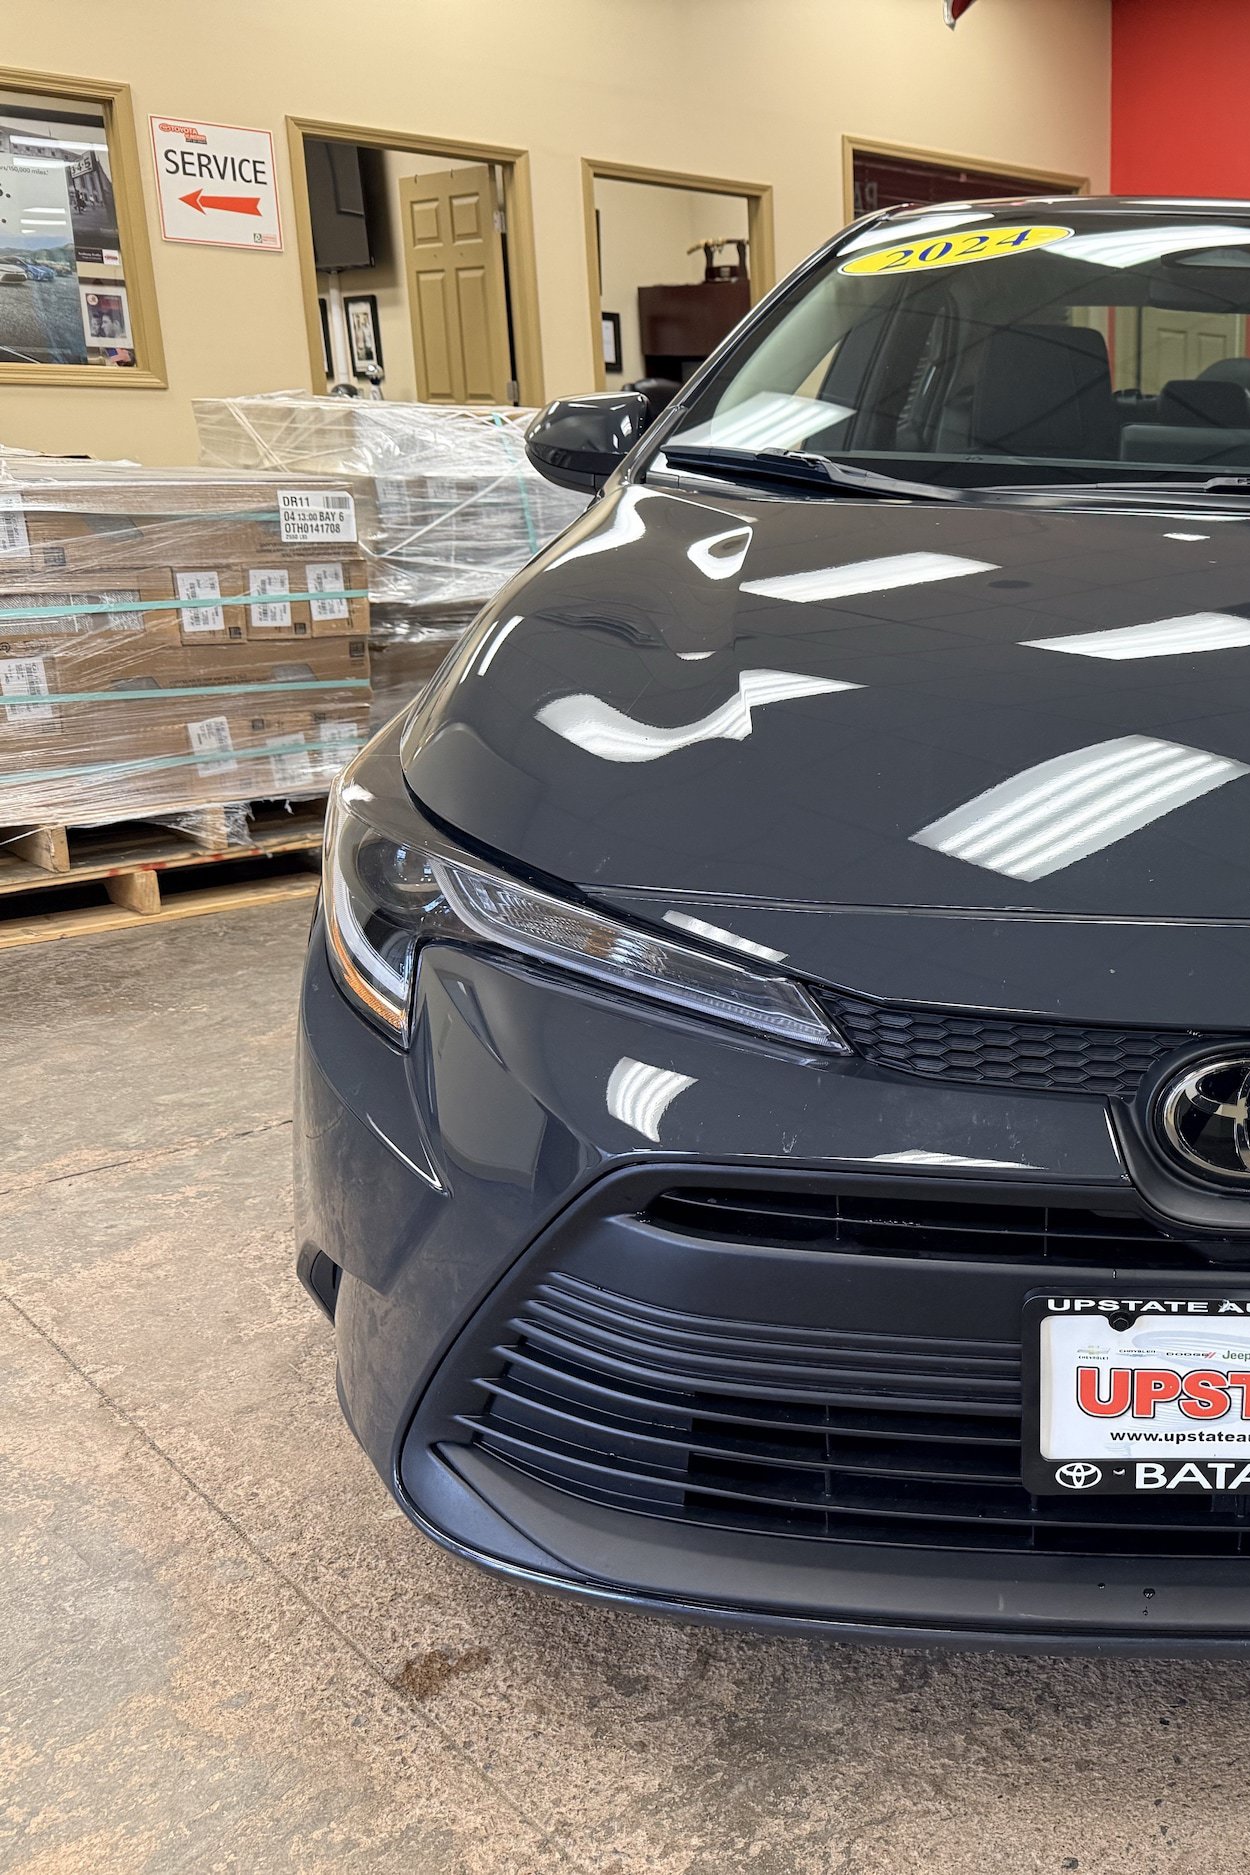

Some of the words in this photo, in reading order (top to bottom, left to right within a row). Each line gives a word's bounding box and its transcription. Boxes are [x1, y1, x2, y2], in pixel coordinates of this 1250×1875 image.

[164, 148, 268, 186] SERVICE
[879, 228, 1033, 271] 2024
[282, 496, 310, 507] DR11
[284, 511, 295, 521] 04
[319, 511, 336, 522] BAY
[338, 511, 344, 522] 6
[1047, 1298, 1209, 1313] UPSTATE
